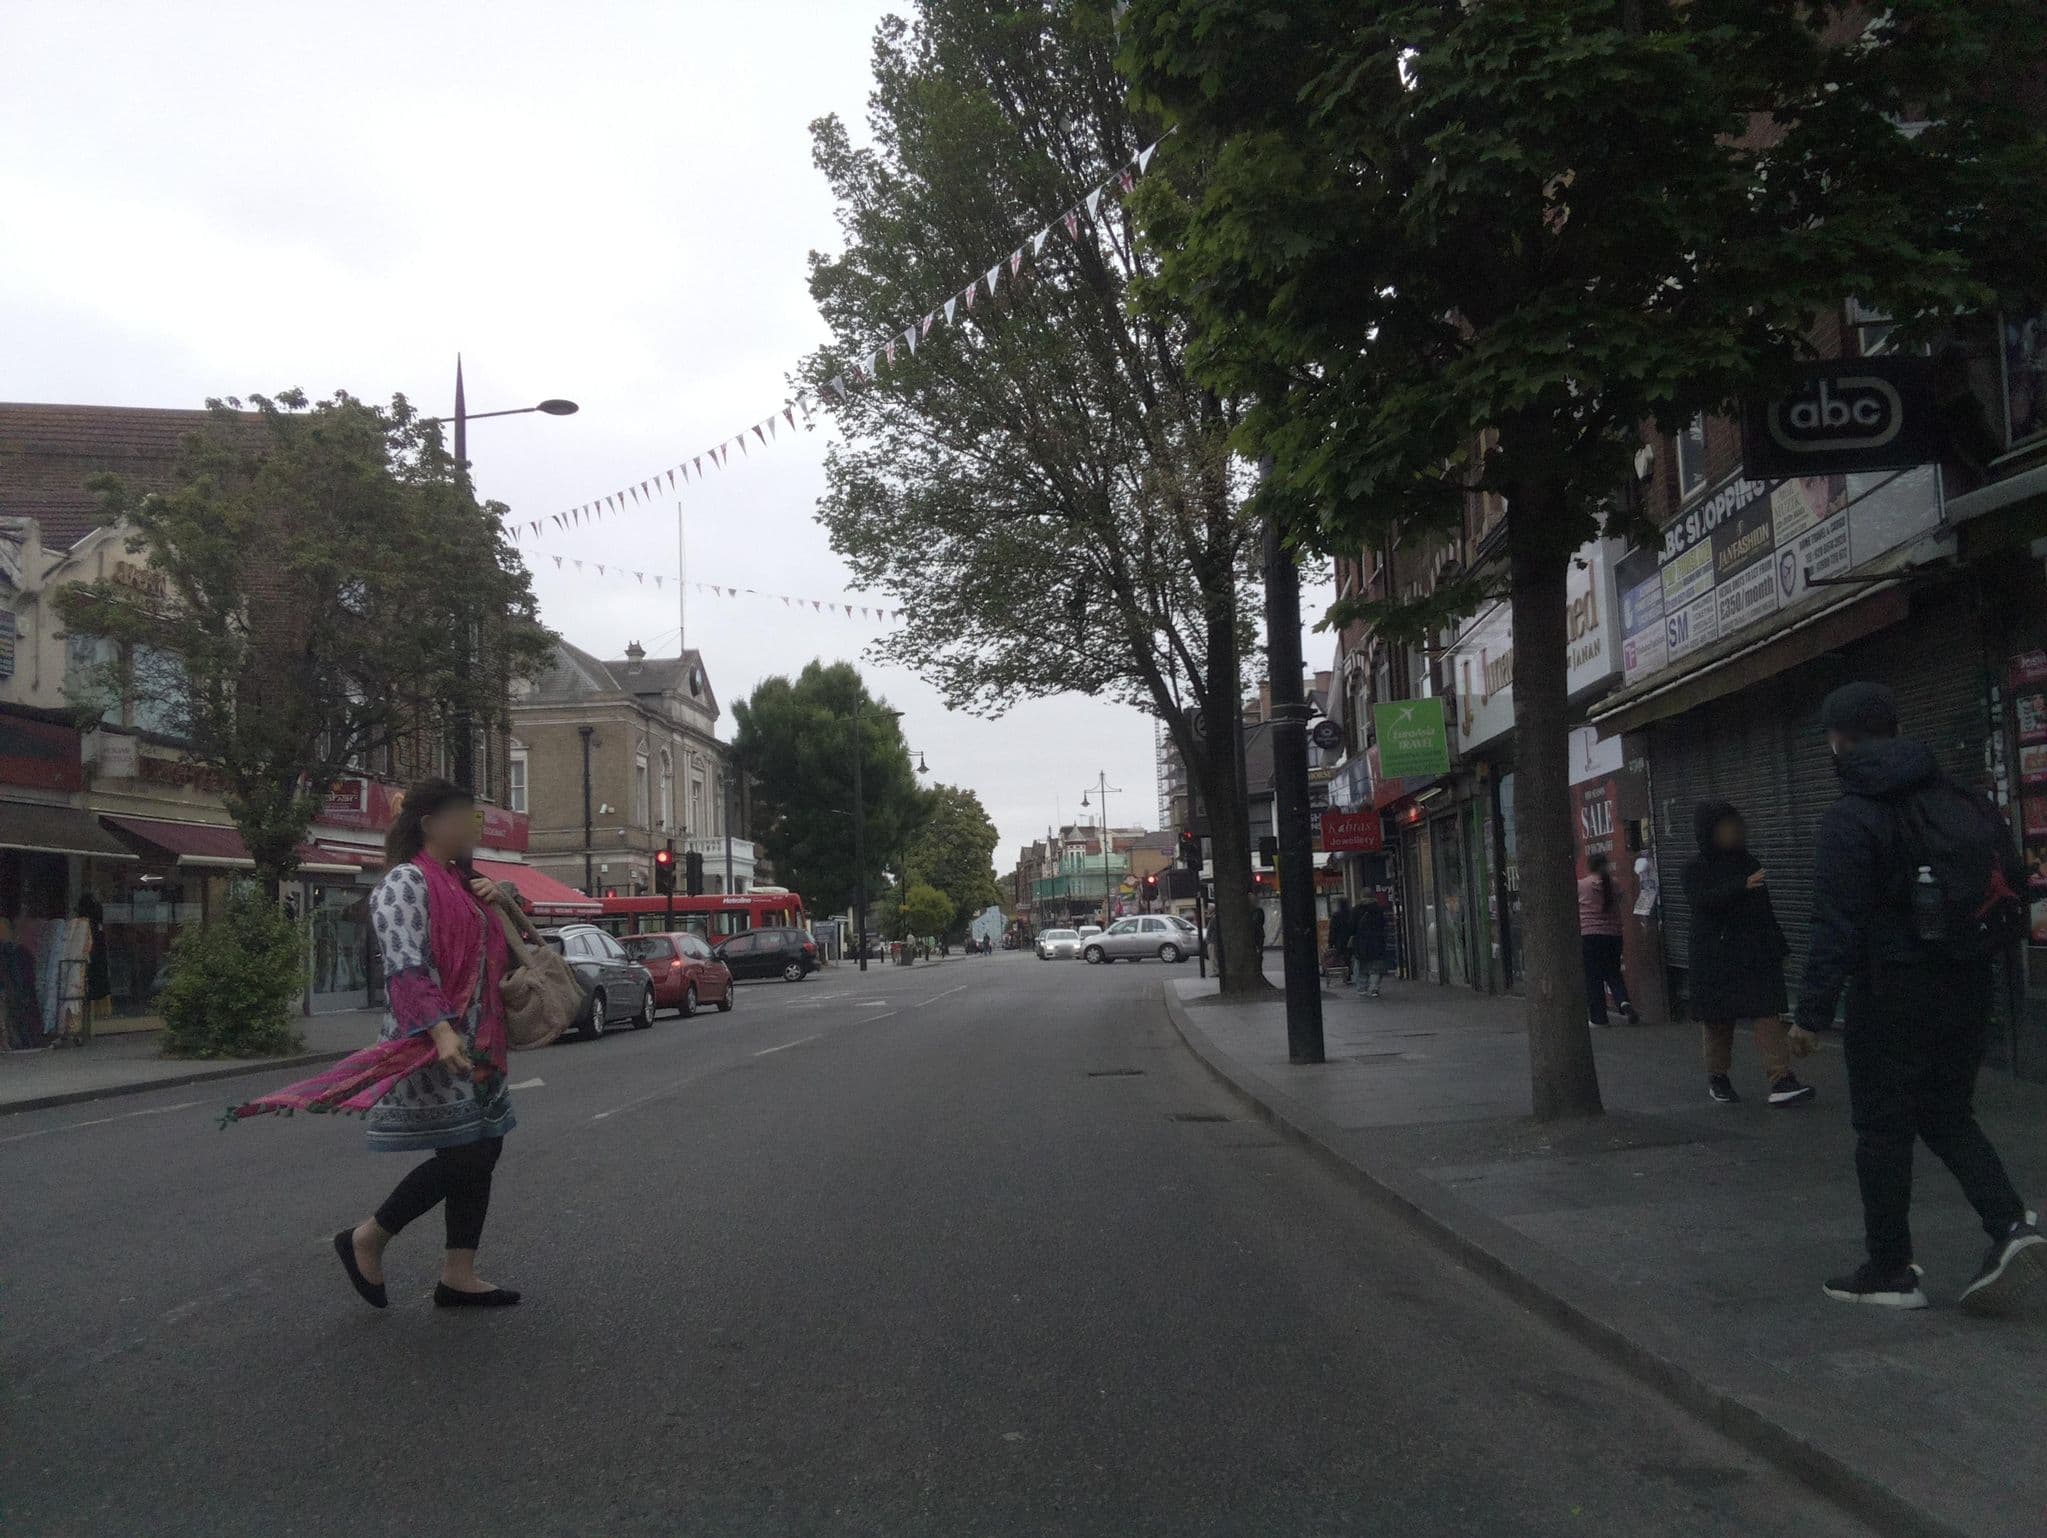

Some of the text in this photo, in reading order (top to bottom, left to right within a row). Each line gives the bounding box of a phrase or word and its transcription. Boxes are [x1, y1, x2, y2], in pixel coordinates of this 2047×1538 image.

[1790, 378, 1881, 428] abc
[1668, 611, 1689, 648] SM
[1581, 800, 1615, 840] SALE
[722, 896, 752, 905] Metroline
